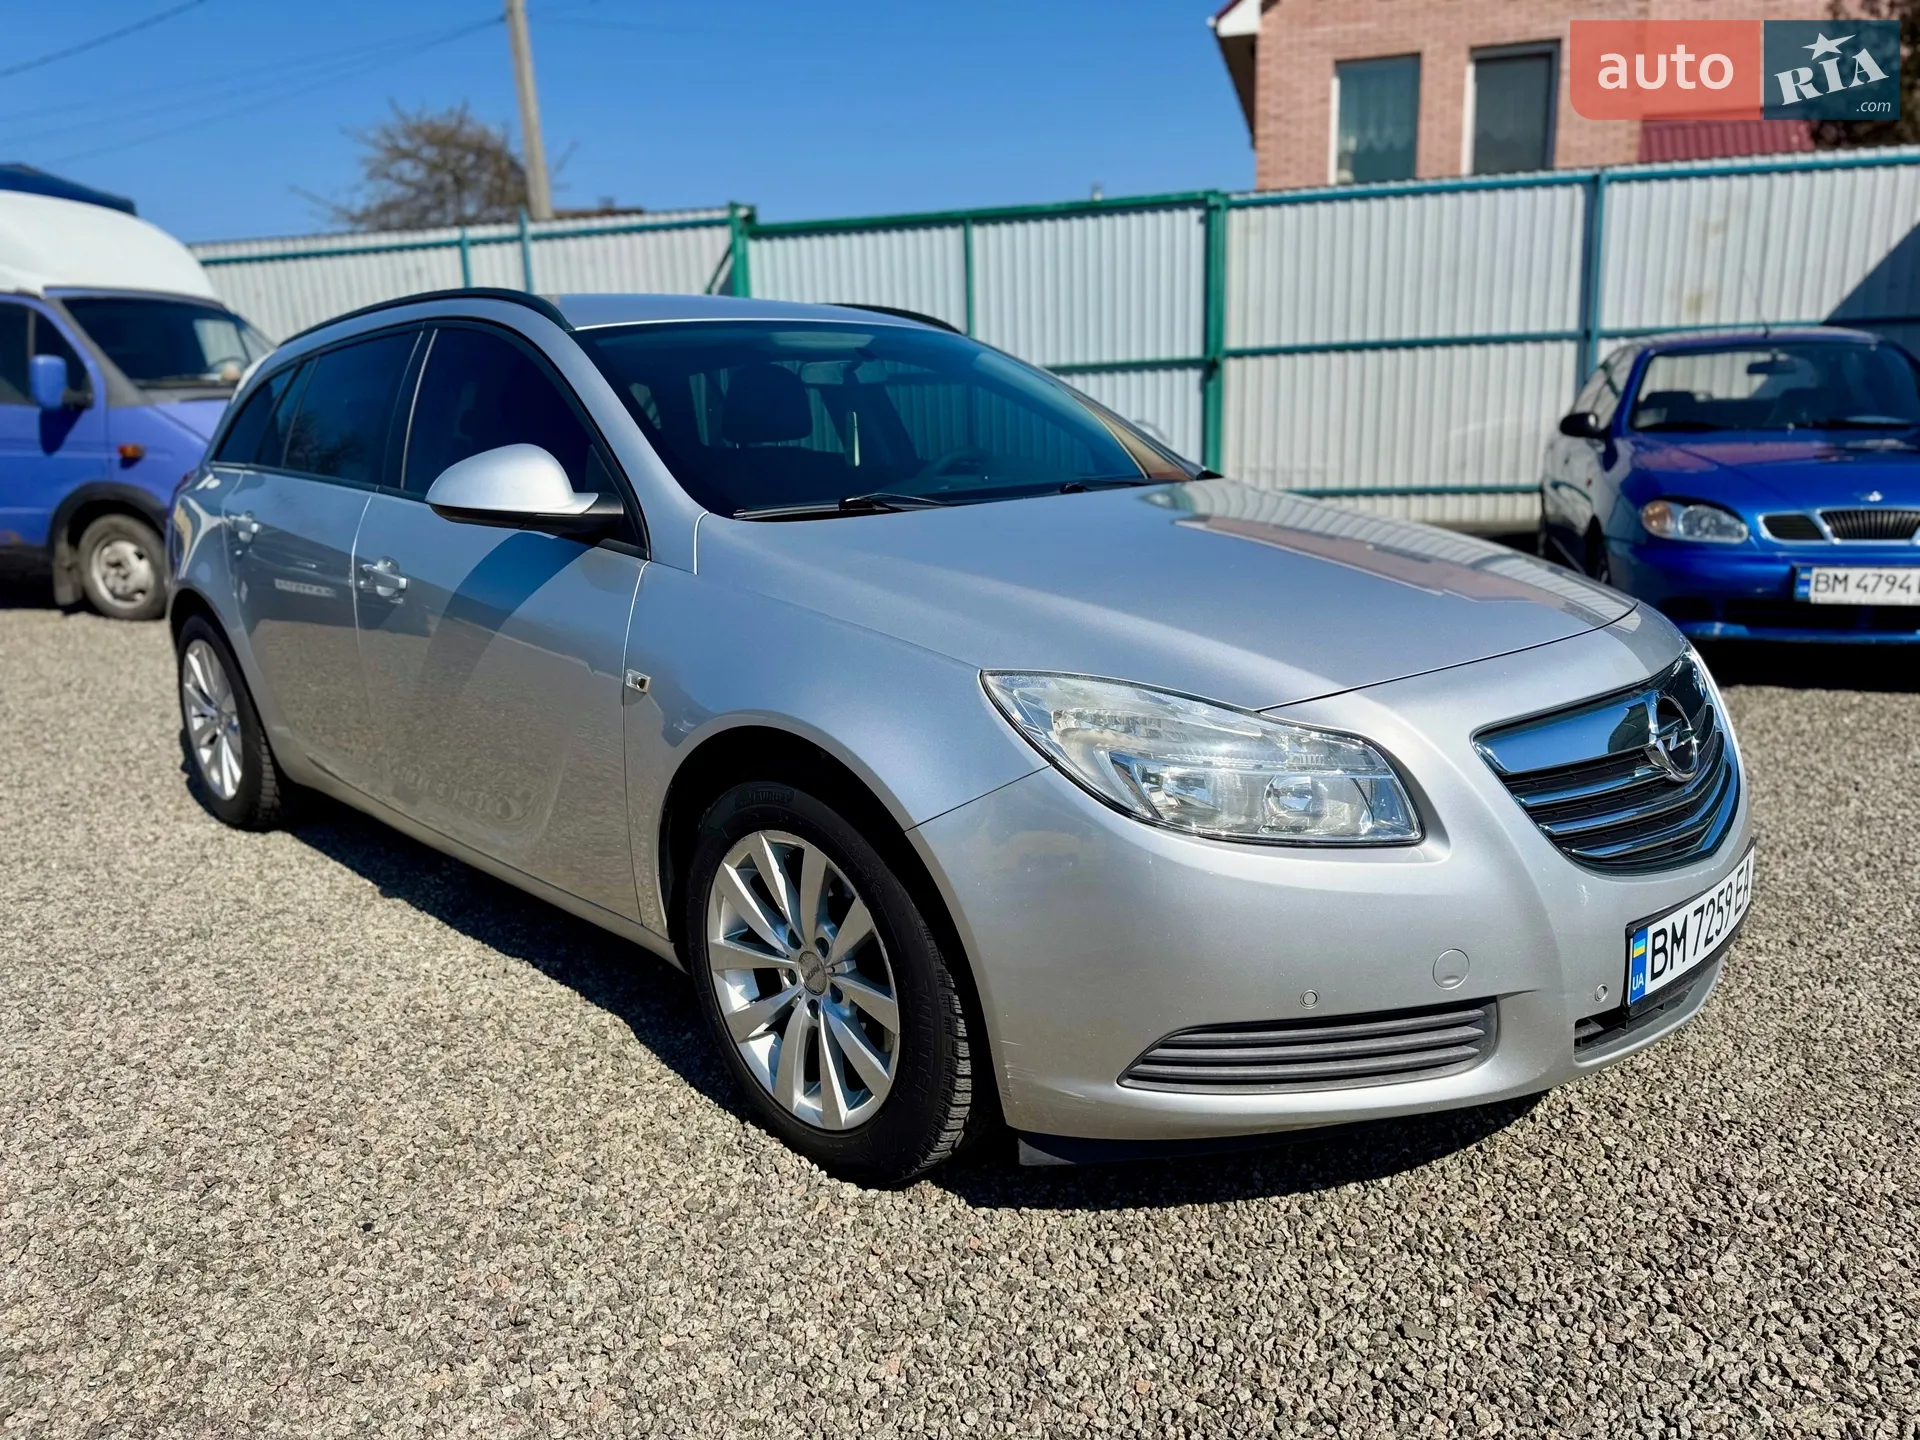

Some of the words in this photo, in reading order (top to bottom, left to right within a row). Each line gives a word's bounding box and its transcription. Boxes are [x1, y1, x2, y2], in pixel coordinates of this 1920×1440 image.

[1814, 573, 1849, 593] BM
[1856, 573, 1911, 594] 4794
[1650, 914, 1688, 982] BM
[1693, 881, 1733, 957] 7259
[1735, 859, 1750, 917] EA
[1632, 976, 1645, 991] UA
